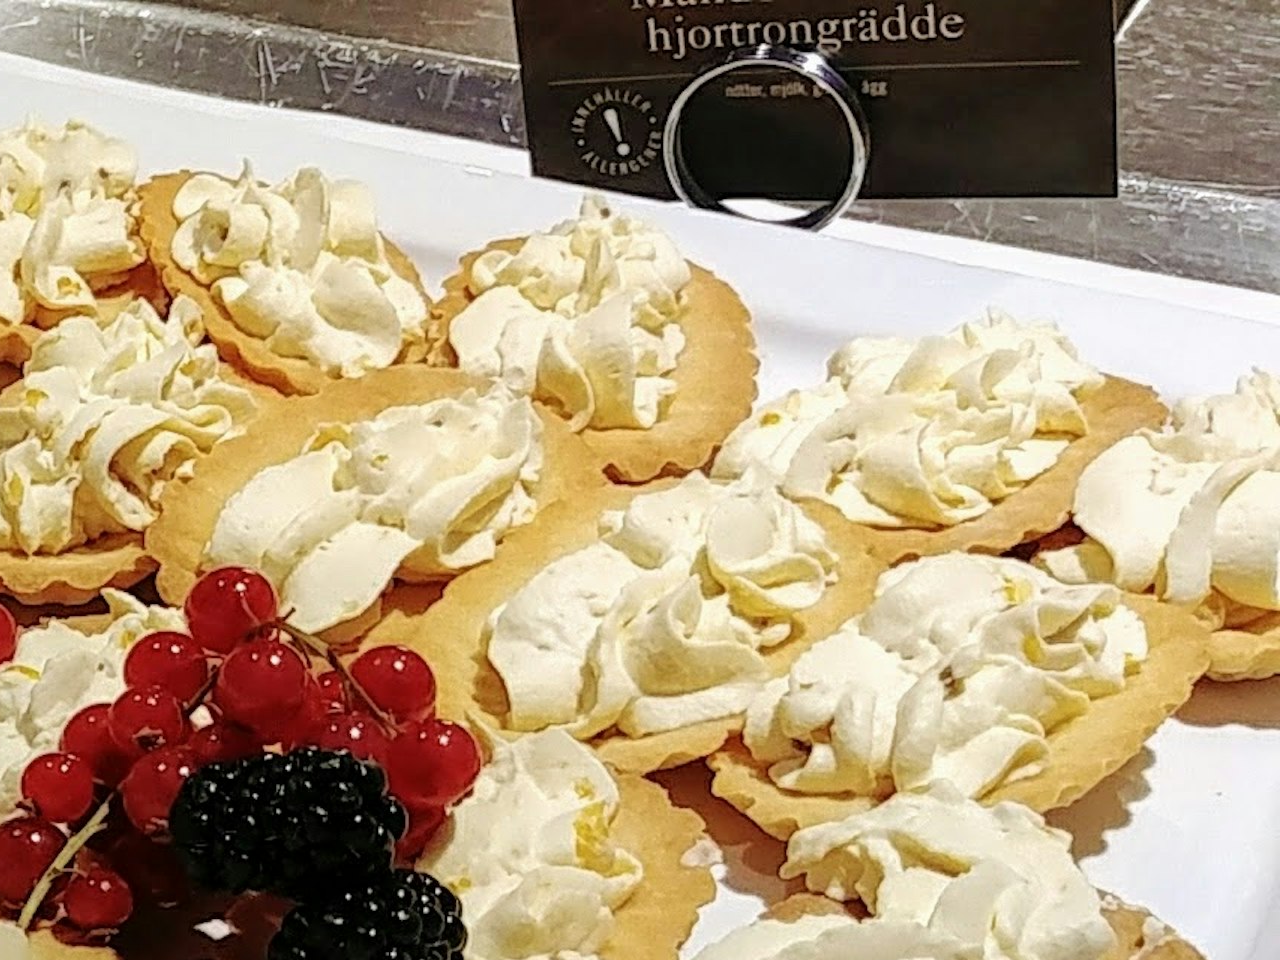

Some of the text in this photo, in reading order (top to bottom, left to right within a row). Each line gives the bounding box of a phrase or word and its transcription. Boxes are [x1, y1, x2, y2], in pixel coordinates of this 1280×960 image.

[645, 3, 966, 59] hjortrongrädde
[570, 86, 652, 133] INNEHÅLLER
[581, 131, 662, 176] ALLERGENER
